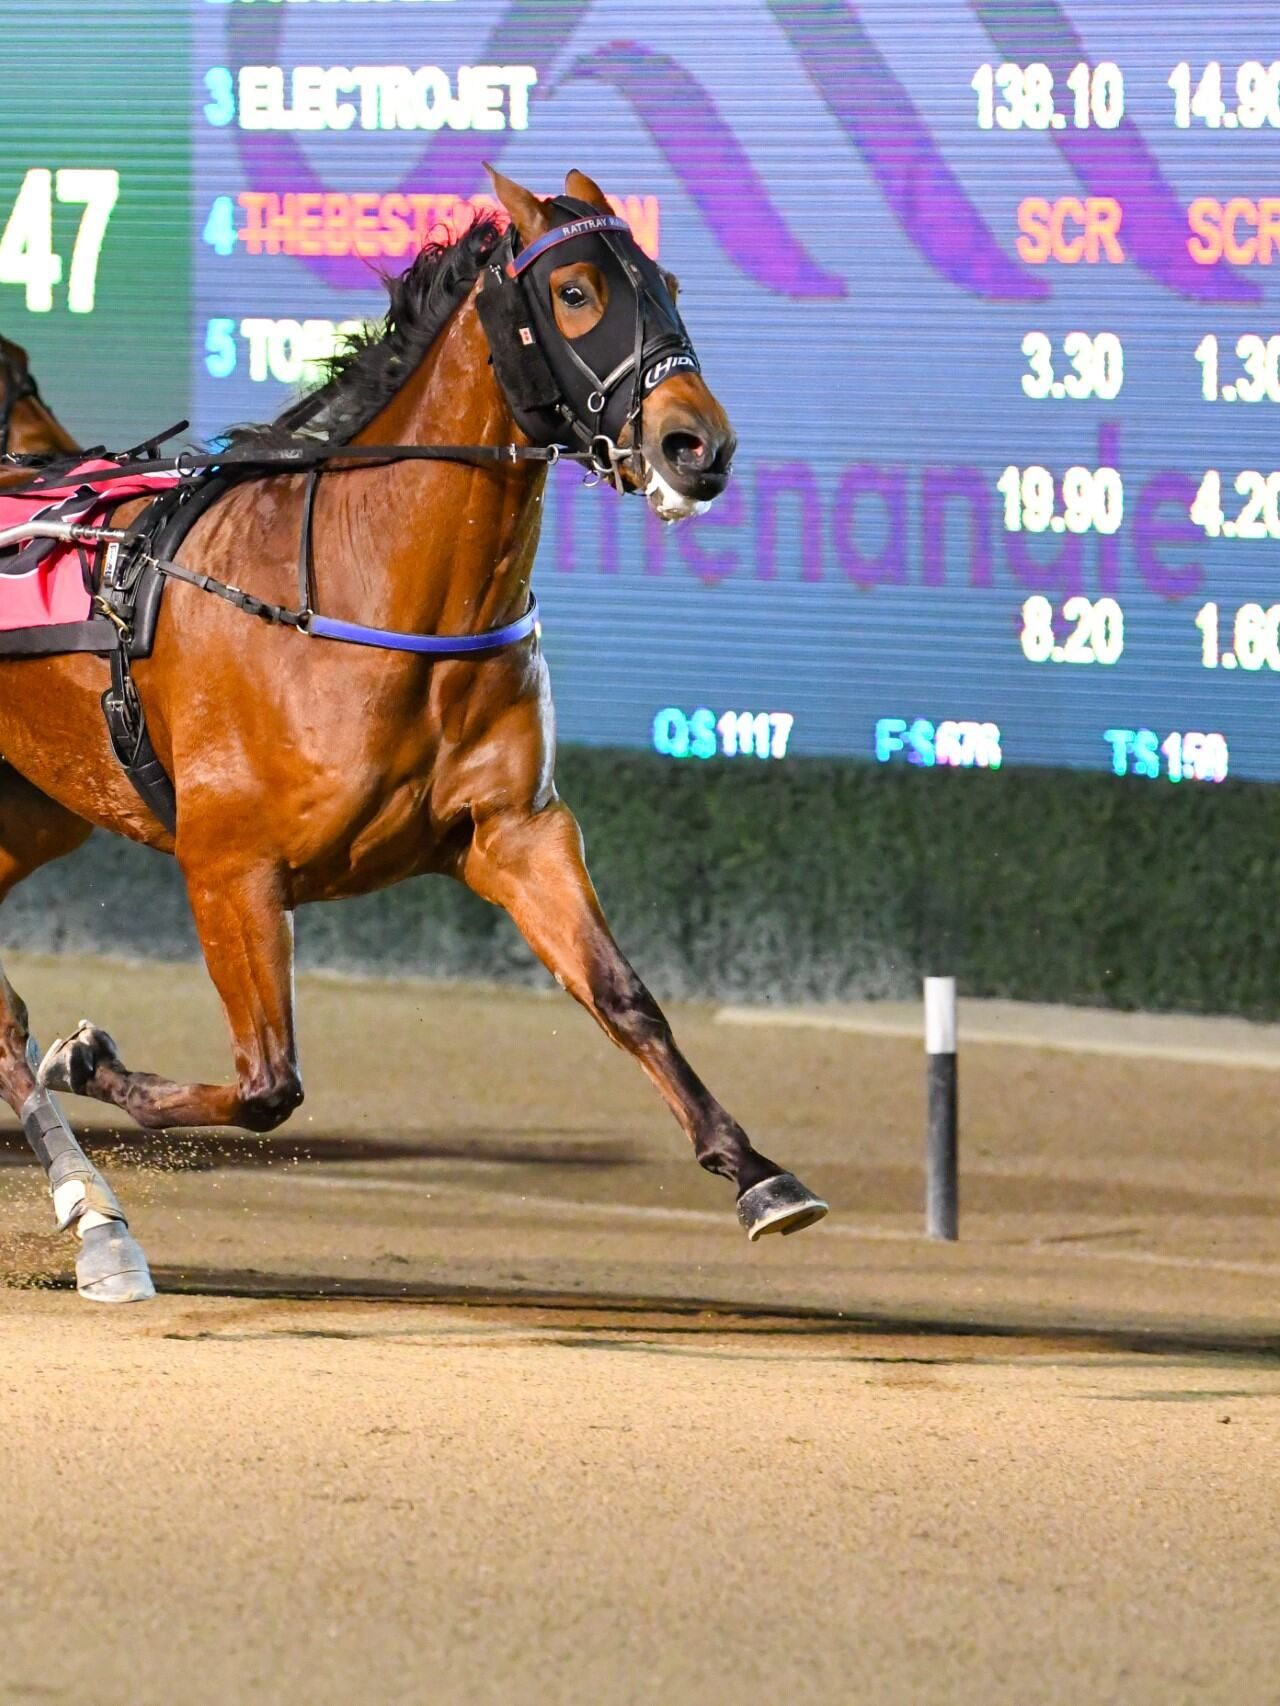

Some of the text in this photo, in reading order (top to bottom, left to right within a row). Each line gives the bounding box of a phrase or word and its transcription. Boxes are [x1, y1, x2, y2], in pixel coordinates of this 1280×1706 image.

[204, 66, 235, 127] 3
[238, 66, 537, 130] ELECTROJET
[971, 62, 1124, 129] 138.10
[203, 196, 237, 256] 4
[1016, 196, 1124, 264] SCR
[562, 217, 607, 236] RATTRAY
[205, 317, 237, 379] 5
[1021, 332, 1123, 400] 3.30
[997, 466, 1124, 534] 19.90
[1021, 595, 1124, 664] 8.20
